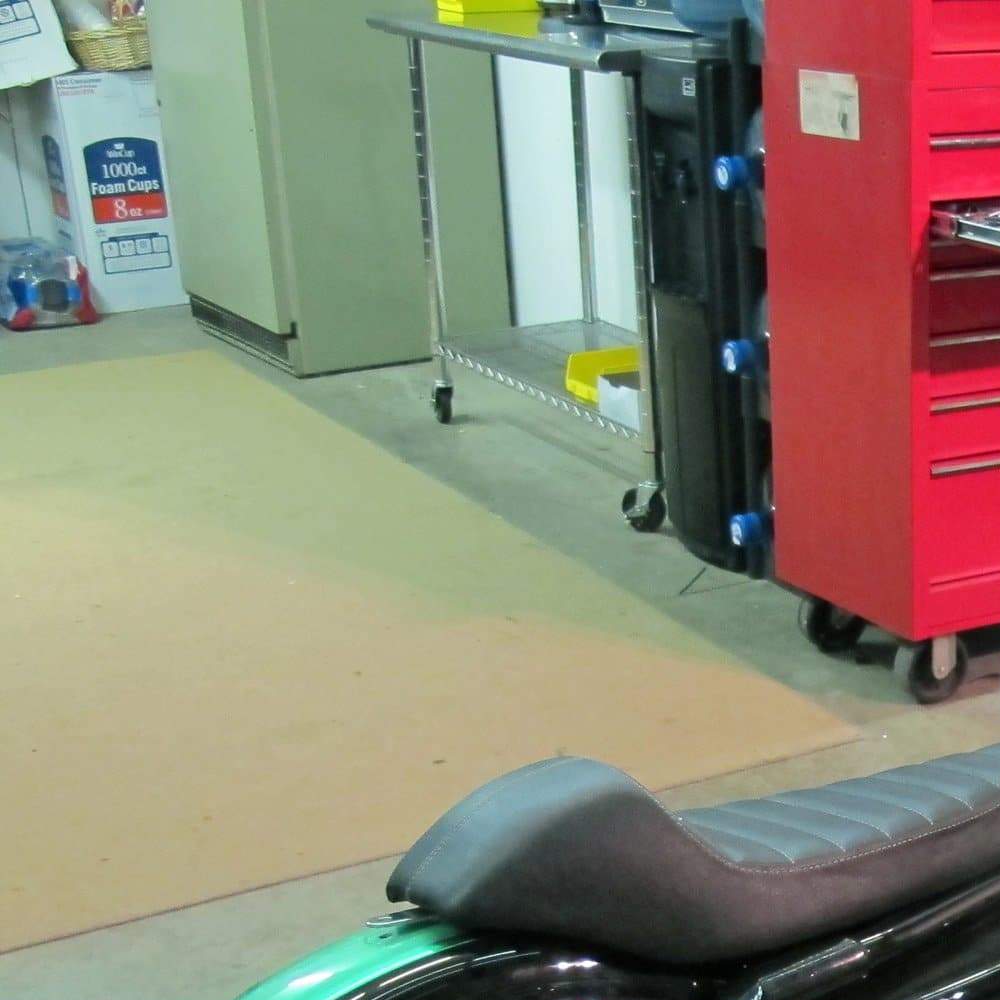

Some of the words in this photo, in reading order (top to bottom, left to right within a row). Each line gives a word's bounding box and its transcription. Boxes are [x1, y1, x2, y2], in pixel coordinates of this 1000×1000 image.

[91, 182, 126, 195] Foam
[127, 179, 160, 193] Cups
[114, 199, 128, 219] 8
[129, 208, 144, 217] oz
